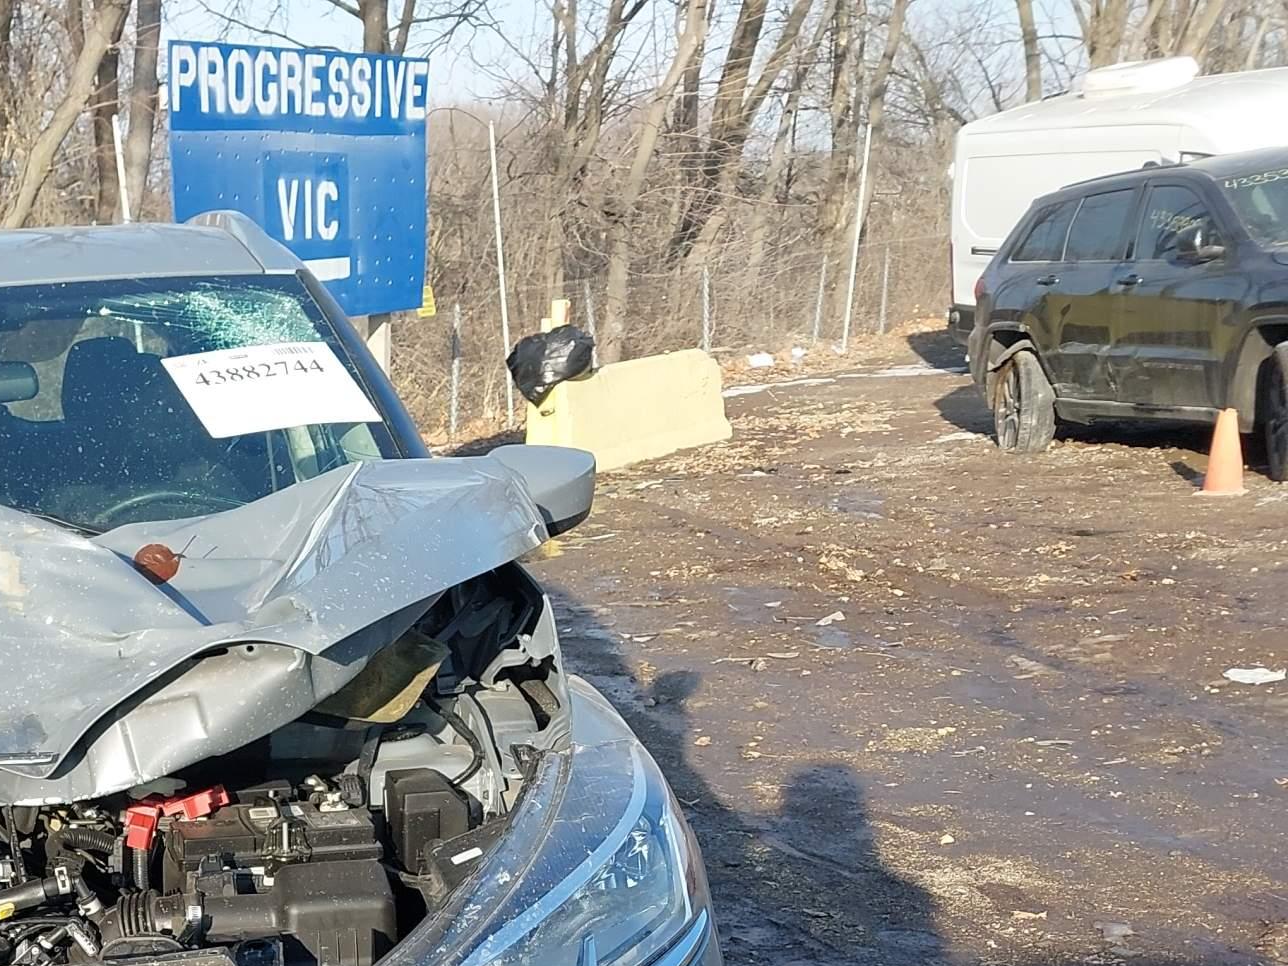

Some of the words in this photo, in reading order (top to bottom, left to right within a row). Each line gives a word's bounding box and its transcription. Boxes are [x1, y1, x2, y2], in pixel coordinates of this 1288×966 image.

[171, 44, 428, 120] PROGRESSIVE
[277, 178, 339, 241] VIC
[195, 359, 325, 387] 43882744
